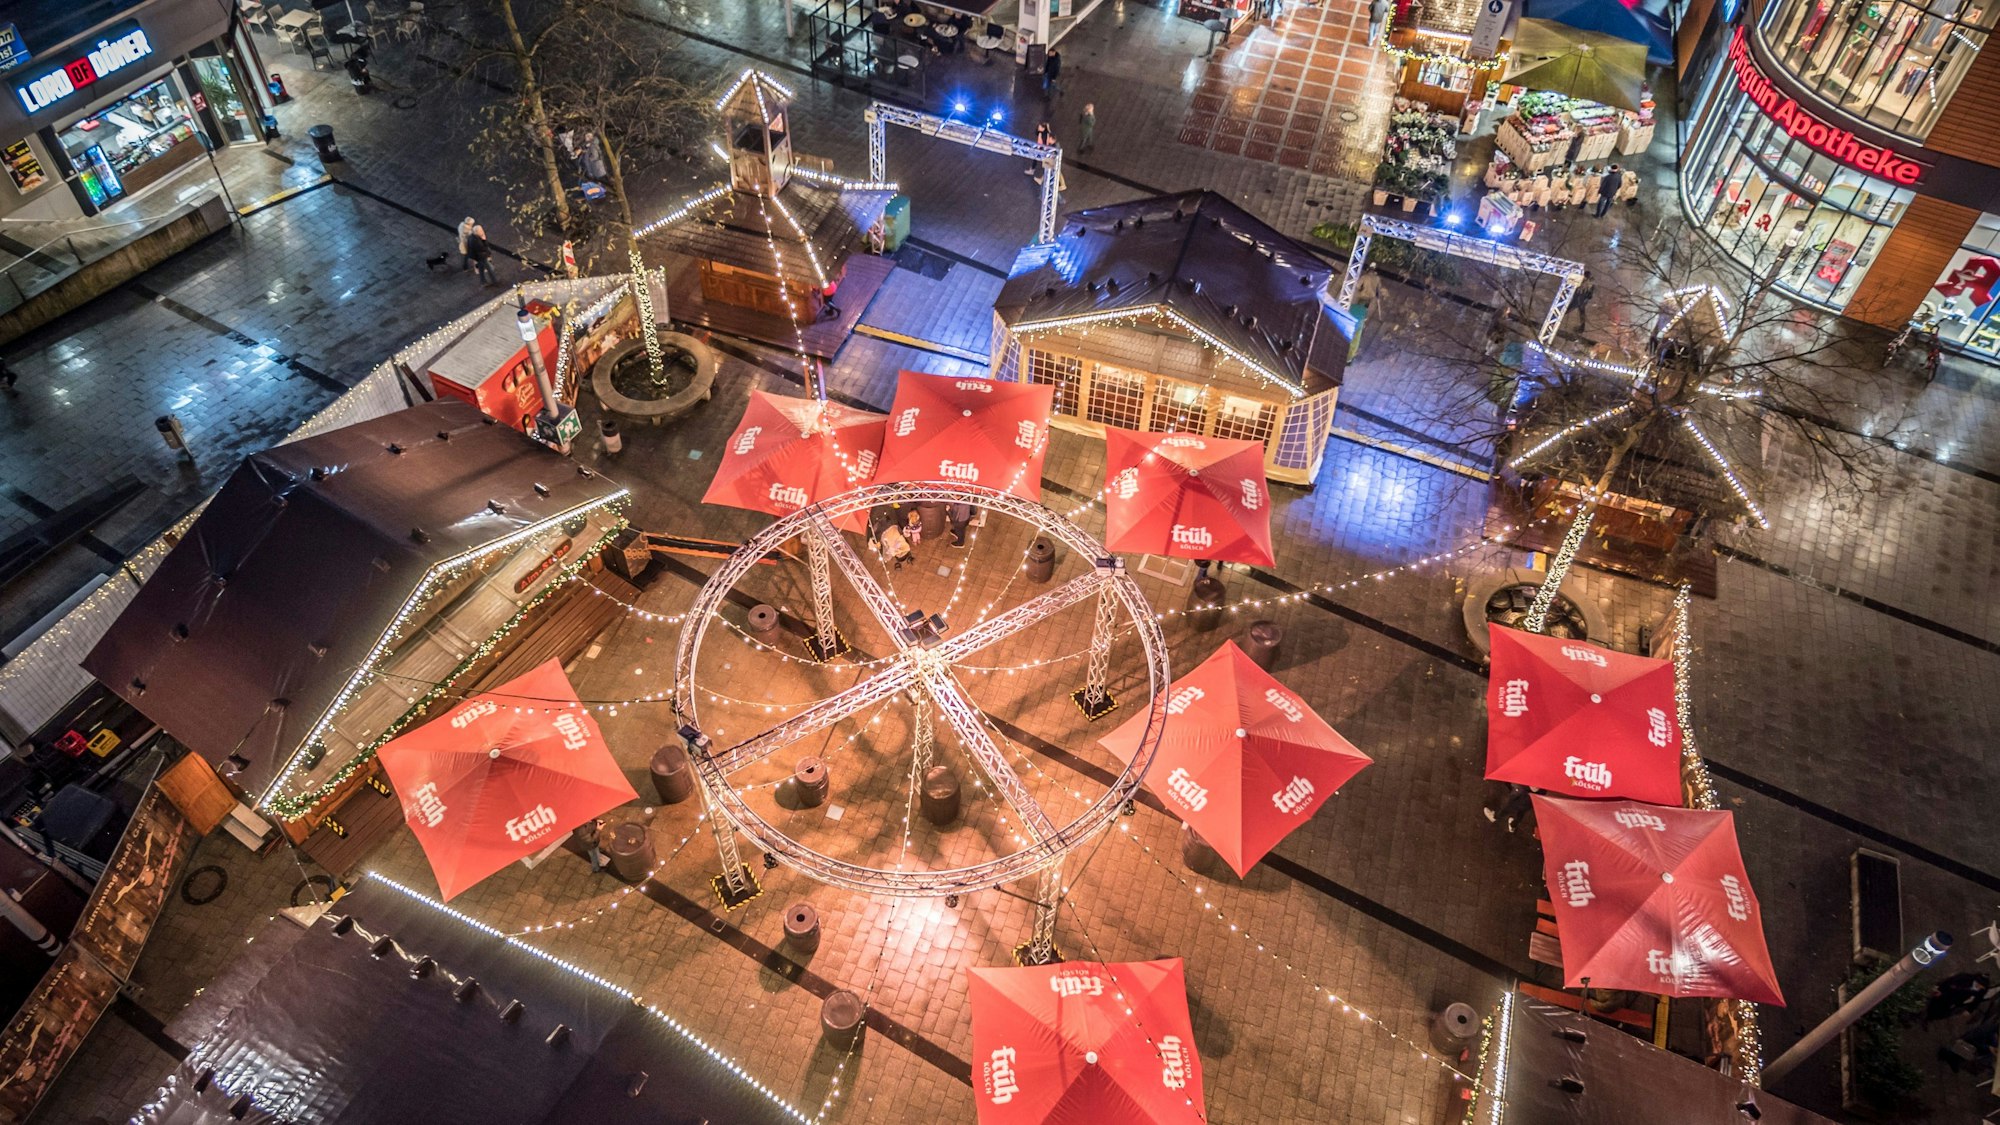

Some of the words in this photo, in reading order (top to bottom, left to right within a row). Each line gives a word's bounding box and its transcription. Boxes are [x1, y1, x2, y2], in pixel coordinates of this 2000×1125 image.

[18, 68, 75, 113] LORD
[71, 62, 90, 83] OF
[87, 29, 152, 78] DÖNER
[1729, 25, 1779, 112] Pinguin
[1773, 99, 1920, 185] Apotheke
[955, 381, 994, 393] früh
[896, 407, 921, 437] früh
[1014, 419, 1037, 449] früh
[734, 425, 763, 455] früh
[851, 448, 877, 480] früh
[938, 459, 979, 482] früh
[768, 482, 809, 508] früh
[1118, 467, 1140, 499] früh
[1240, 478, 1258, 511] früh
[1171, 523, 1213, 548] früh
[520, 545, 569, 589] Alm-Stbe
[1561, 645, 1608, 668] früh
[1162, 686, 1205, 715] früh
[1265, 688, 1304, 723] früh
[1503, 678, 1530, 718] früh
[450, 700, 498, 729] früh
[1646, 706, 1668, 748] früh
[552, 712, 588, 751] früh
[1563, 755, 1612, 789] früh
[1574, 779, 1601, 792] KÖLSCH
[414, 781, 448, 828] früh
[1167, 767, 1208, 812] früh
[1167, 788, 1191, 811] KÖLSCH
[1272, 774, 1315, 814] früh
[1292, 795, 1313, 816] KÖLSCH
[504, 803, 557, 842] früh
[524, 826, 552, 845] KÖLSCH
[1615, 810, 1667, 832] früh
[1557, 871, 1568, 899] KÖLSCH
[1564, 859, 1596, 908] früh
[1720, 873, 1748, 922] früh
[1050, 975, 1104, 998] früh
[983, 1061, 992, 1095] KÖLSCH
[991, 1045, 1020, 1105] früh
[1156, 1035, 1182, 1091] früh
[1182, 1047, 1192, 1079] KÖLSCH
